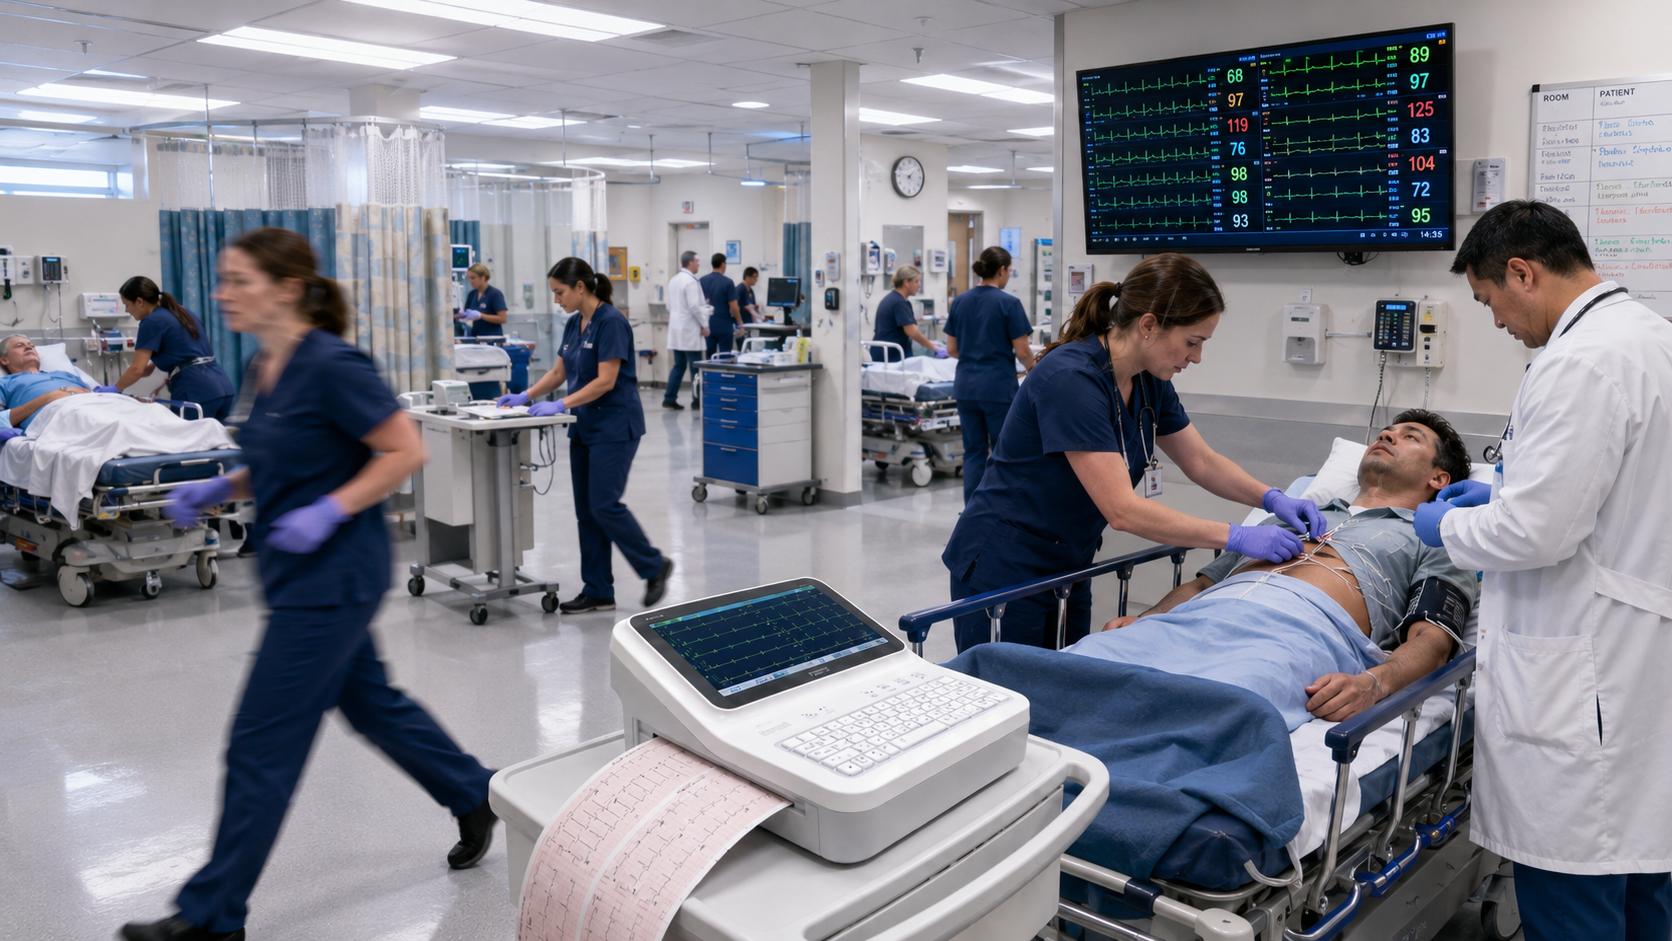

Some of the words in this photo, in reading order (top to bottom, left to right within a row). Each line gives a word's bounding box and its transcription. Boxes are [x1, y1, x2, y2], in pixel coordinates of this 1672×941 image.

[1410, 46, 1430, 63] 89
[1227, 69, 1243, 84] 68
[1410, 73, 1430, 89] 97
[1228, 93, 1243, 107] 97
[1543, 93, 1569, 102] ROOM
[1600, 88, 1635, 98] PATIENT
[1407, 101, 1434, 118] 125
[1227, 118, 1249, 133] 119
[1411, 128, 1430, 144] 83
[1230, 142, 1246, 156] 76
[1408, 156, 1435, 172] 104
[1231, 167, 1247, 181] 98
[1411, 181, 1431, 197] 72
[1232, 190, 1248, 204] 98
[1233, 214, 1249, 228] 93
[1411, 208, 1431, 223] 95
[1420, 230, 1443, 239] 14:35
